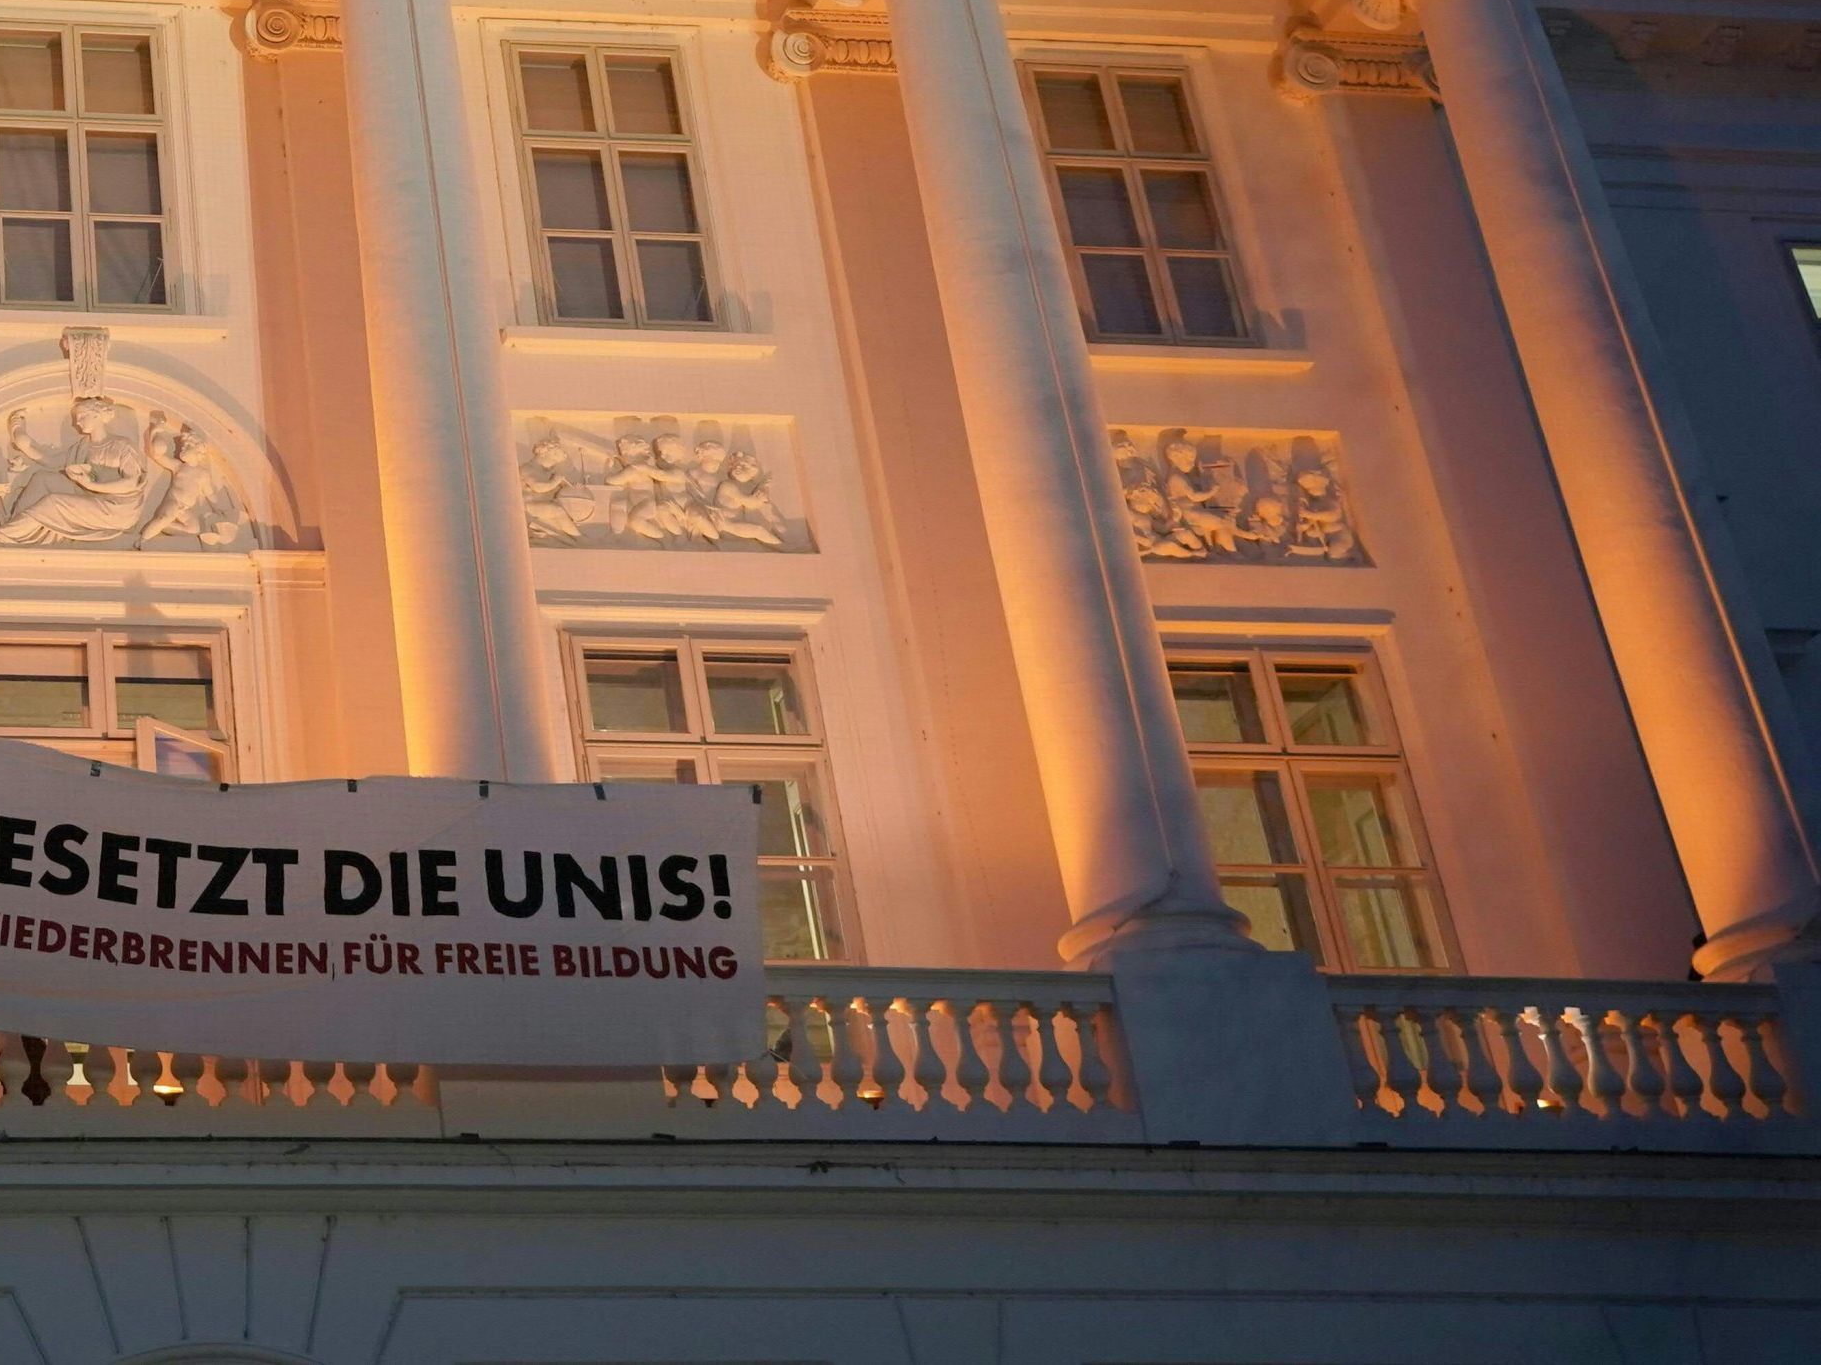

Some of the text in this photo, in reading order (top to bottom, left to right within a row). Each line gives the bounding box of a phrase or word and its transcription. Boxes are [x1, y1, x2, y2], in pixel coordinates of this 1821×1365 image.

[323, 849, 460, 917] DIE
[484, 849, 733, 922] UNIS!
[342, 933, 424, 976] FÜR
[434, 942, 540, 977] FREIE
[552, 944, 739, 981] BILDUNG
